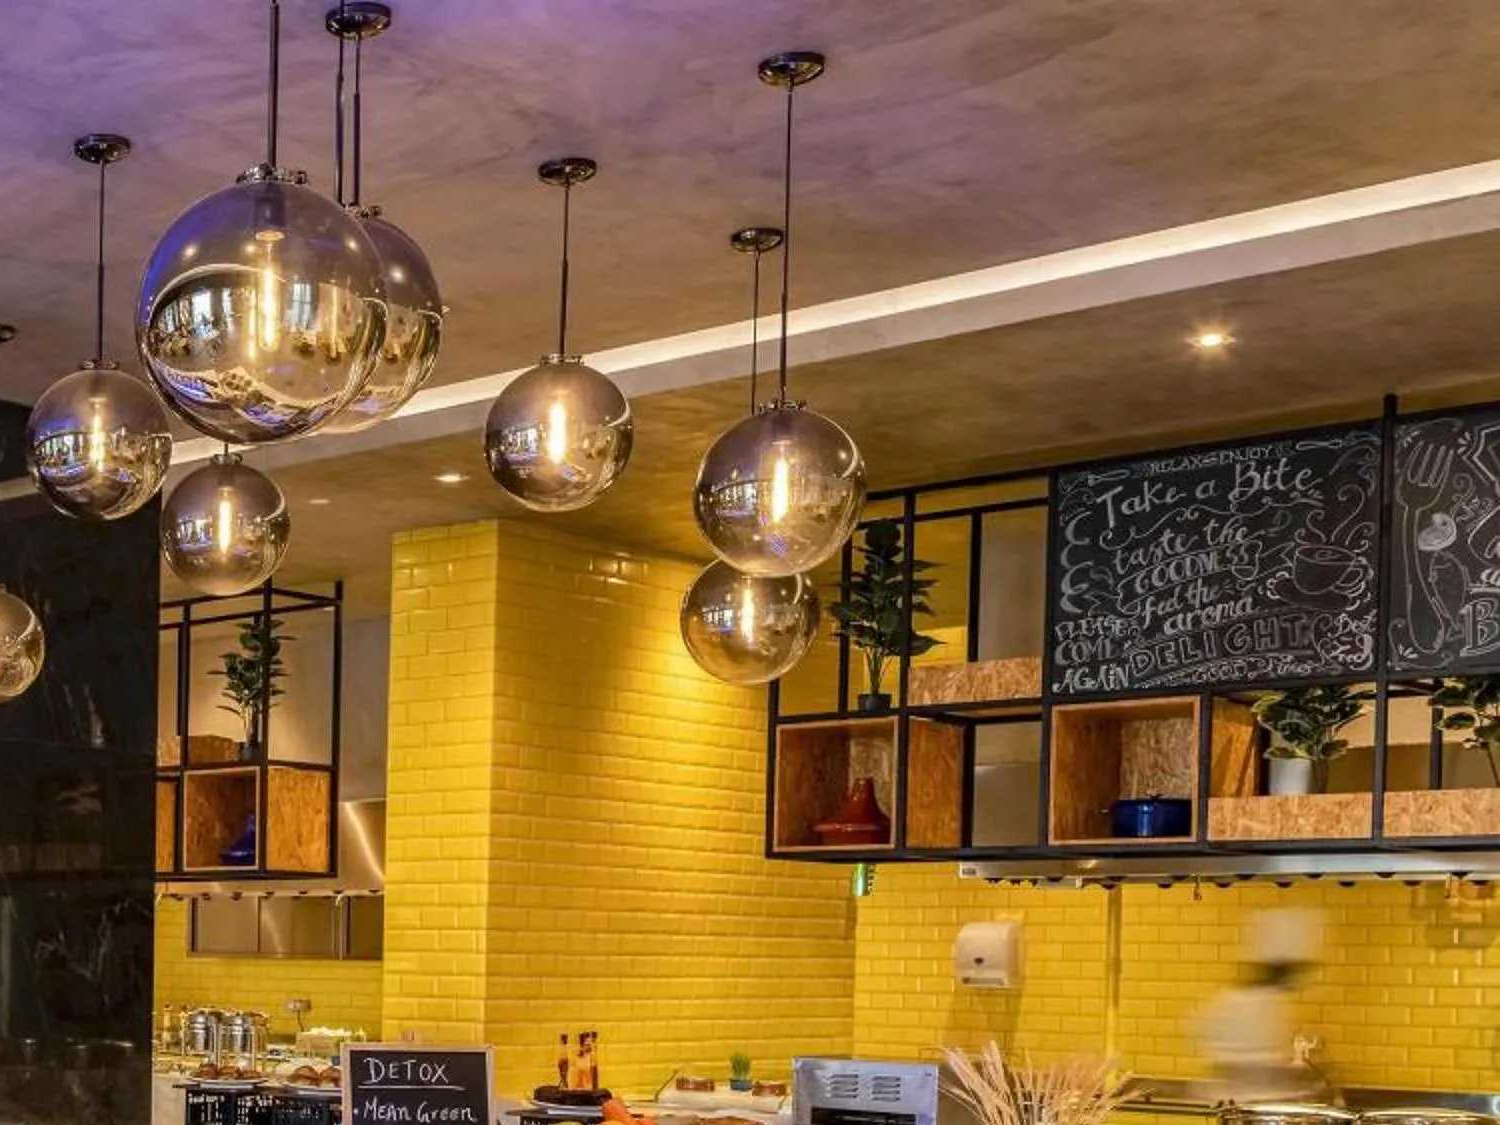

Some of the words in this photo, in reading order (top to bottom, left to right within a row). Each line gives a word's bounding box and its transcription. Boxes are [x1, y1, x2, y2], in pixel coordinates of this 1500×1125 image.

[1219, 445, 1272, 465] ENJOY
[1096, 480, 1187, 529] Take
[1194, 479, 1217, 500] a
[1228, 457, 1323, 505] Bite
[1113, 528, 1200, 575] taste
[1203, 515, 1248, 546] the
[1185, 578, 1223, 609] the
[1055, 614, 1129, 641] PLEASE
[1163, 596, 1256, 635] aroma
[1054, 636, 1118, 666] COME
[1129, 612, 1308, 678] DELIGHT
[360, 1057, 449, 1085] DETOX
[417, 1101, 478, 1123] Green
